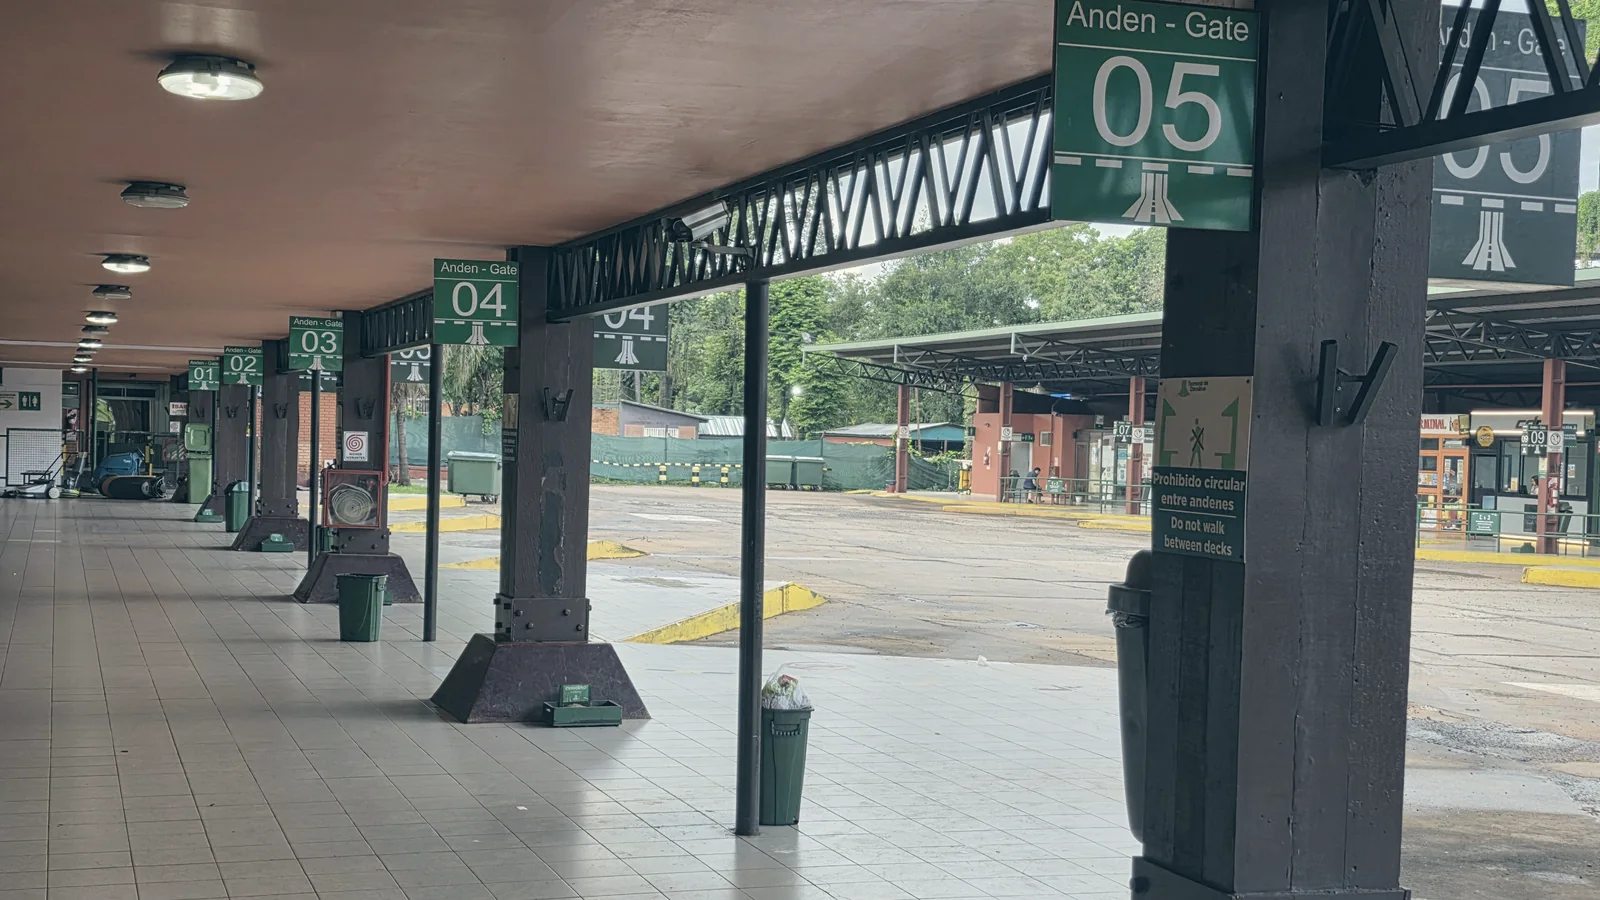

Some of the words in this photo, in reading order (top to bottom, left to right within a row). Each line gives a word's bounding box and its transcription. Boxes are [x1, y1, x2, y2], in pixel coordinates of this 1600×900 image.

[1066, 0, 1155, 33] Anden
[1185, 11, 1249, 42] Gate
[1092, 55, 1222, 152] 05
[1440, 71, 1551, 184] 05
[440, 261, 478, 274] Anden
[489, 263, 518, 275] Gate
[452, 281, 507, 318] 04
[293, 317, 318, 326] Anden
[325, 319, 343, 328] Gate
[225, 346, 244, 354] Anden
[301, 330, 337, 354] 03
[230, 355, 257, 372] 02
[194, 367, 213, 381] 01
[1119, 424, 1130, 435] 07
[1531, 430, 1545, 444] 09
[1153, 472, 1202, 488] Prohibido
[1204, 475, 1245, 491] circular
[1161, 493, 1187, 506] entre
[1189, 495, 1234, 511] andenes
[1171, 516, 1183, 530] Do
[1185, 518, 1201, 532] not
[1203, 520, 1225, 535] walk
[1164, 534, 1202, 552] between
[1204, 540, 1232, 556] decks
